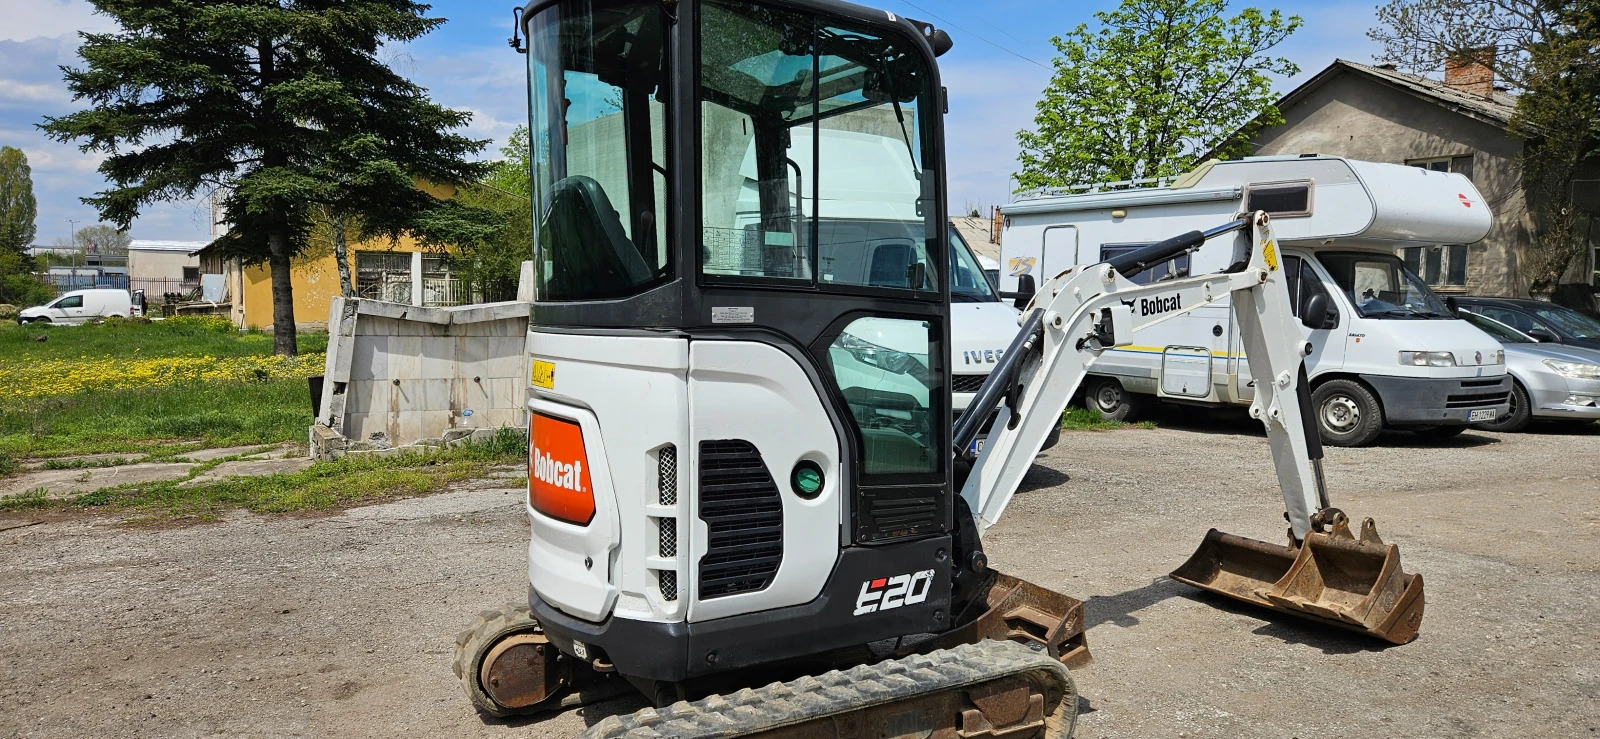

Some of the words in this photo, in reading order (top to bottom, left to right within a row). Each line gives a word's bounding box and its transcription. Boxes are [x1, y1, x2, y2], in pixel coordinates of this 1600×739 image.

[1140, 293, 1182, 317] Bobcat
[963, 349, 1004, 364] IVEC
[534, 447, 582, 492] Bobcat
[853, 569, 935, 616] E20
